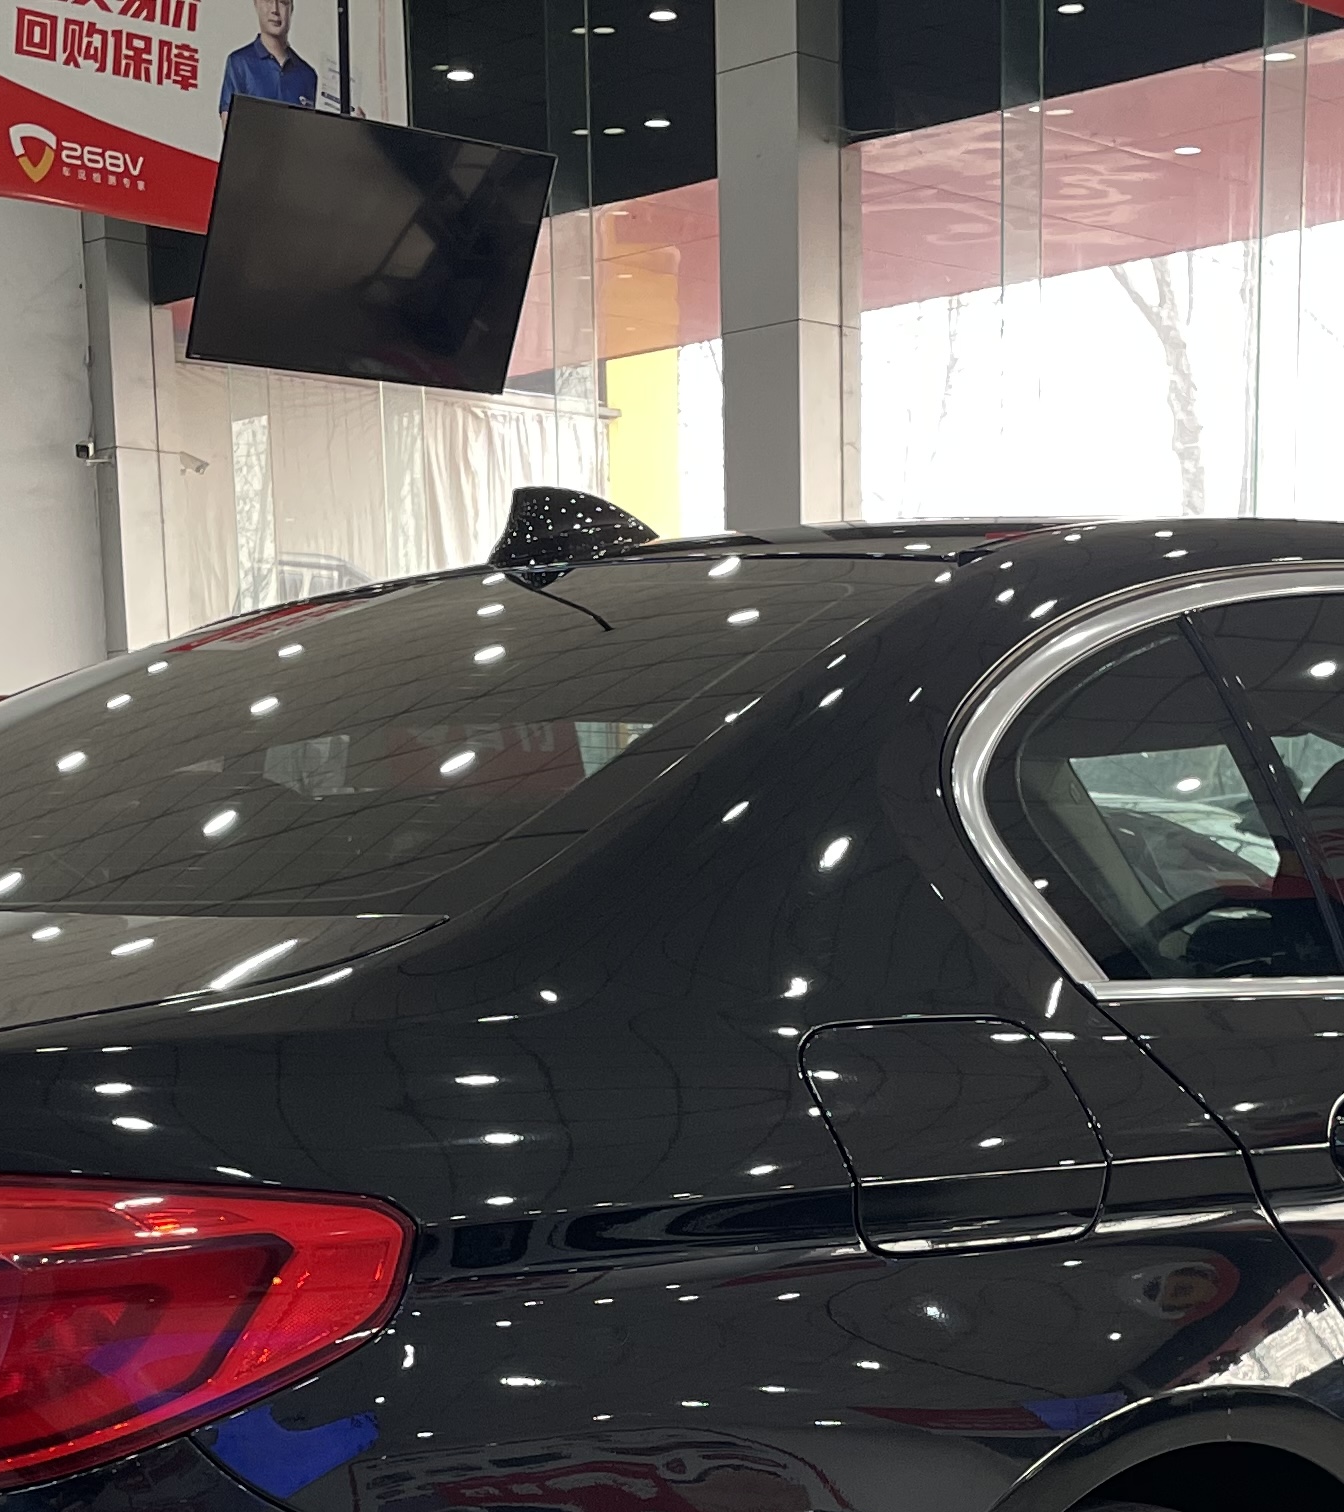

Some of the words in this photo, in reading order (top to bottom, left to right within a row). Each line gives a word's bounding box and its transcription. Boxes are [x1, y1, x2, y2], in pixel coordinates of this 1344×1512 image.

[15, 7, 199, 91] 回购保障
[61, 141, 144, 176] 268V
